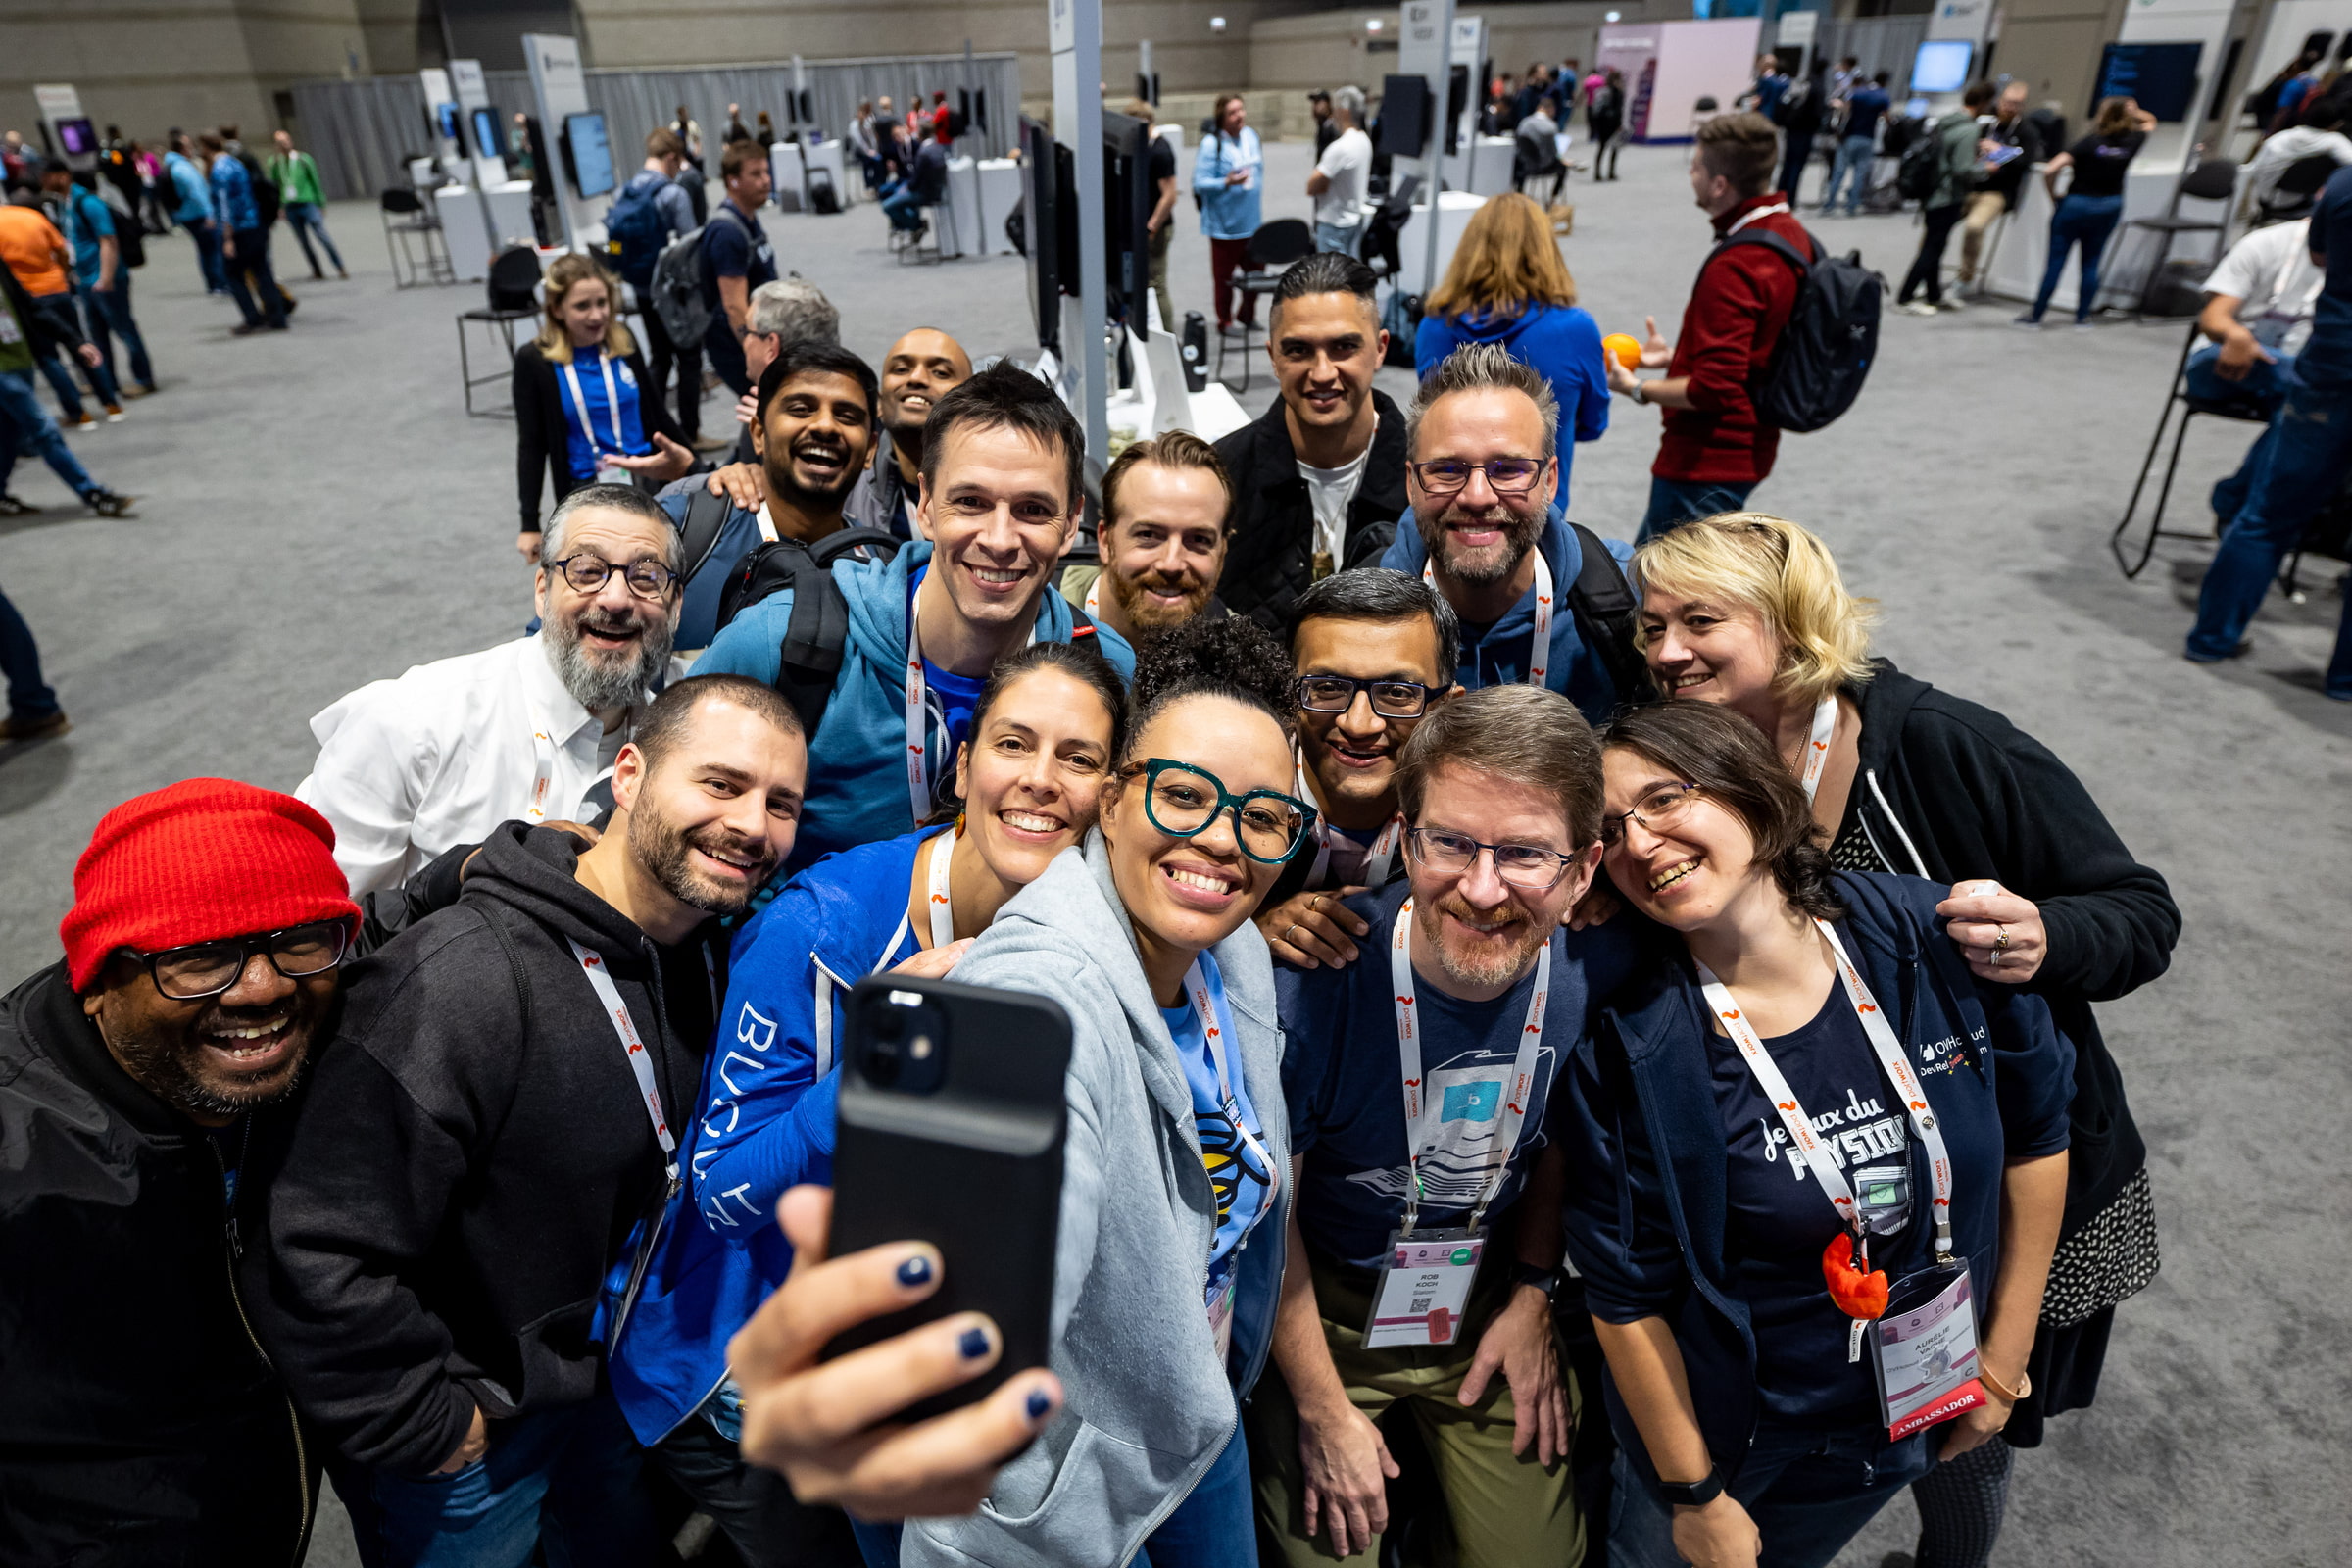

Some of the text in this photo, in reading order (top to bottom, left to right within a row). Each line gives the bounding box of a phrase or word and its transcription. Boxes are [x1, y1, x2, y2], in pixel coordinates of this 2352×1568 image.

[1197, 990, 1214, 1025] portworx
[1403, 1007, 1412, 1039] portworx
[1533, 992, 1543, 1022] portworx
[615, 1009, 634, 1041] portworx
[1936, 1026, 1984, 1055] OVHcud
[1892, 1061, 1917, 1098] portworx
[1921, 1060, 1949, 1076] DevRel
[1515, 1073, 1526, 1102] portworx
[1845, 1088, 1885, 1121] du
[1789, 1114, 1816, 1150] portworx
[1935, 1158, 1946, 1195] portworx
[1914, 1325, 1950, 1351] AURÉLIE
[1919, 1337, 1946, 1355] VACHE
[1896, 1394, 1976, 1435] AMBASSADOR
